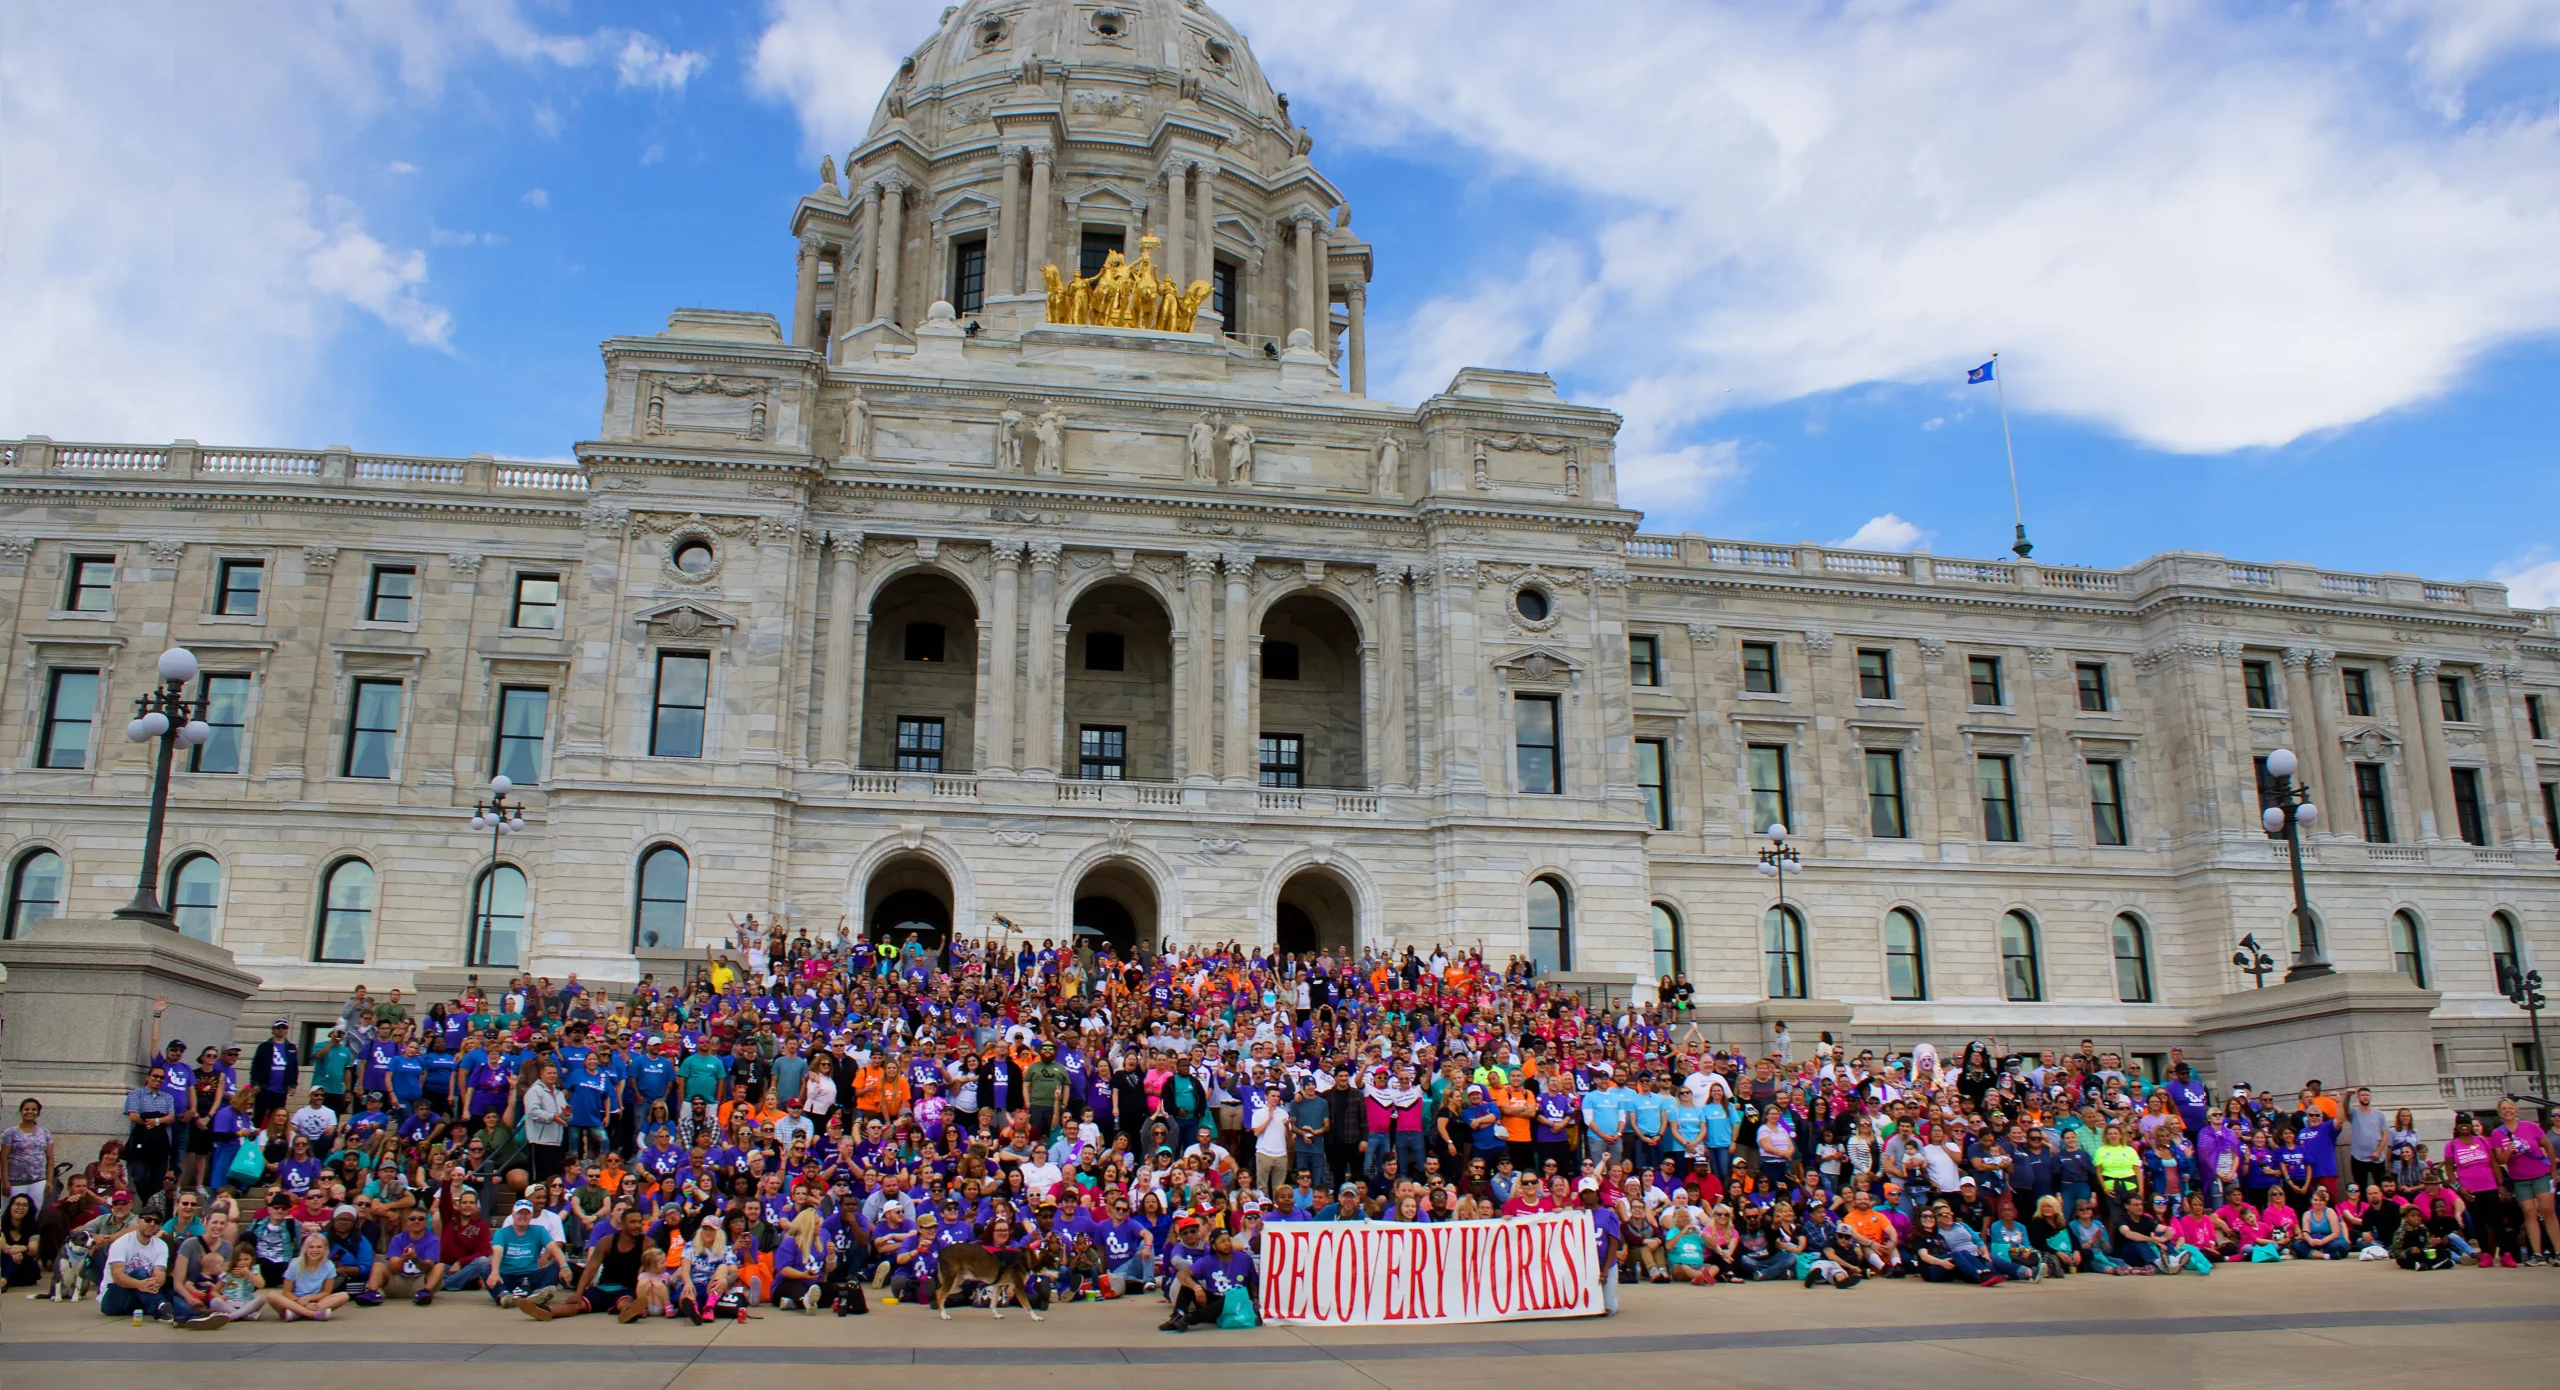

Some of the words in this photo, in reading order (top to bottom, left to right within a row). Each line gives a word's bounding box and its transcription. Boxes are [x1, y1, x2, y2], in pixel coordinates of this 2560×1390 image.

[1155, 988, 1168, 1000] 55
[1263, 1228, 1452, 1322] RECOVERY
[1460, 1217, 1590, 1315] WORKS!
